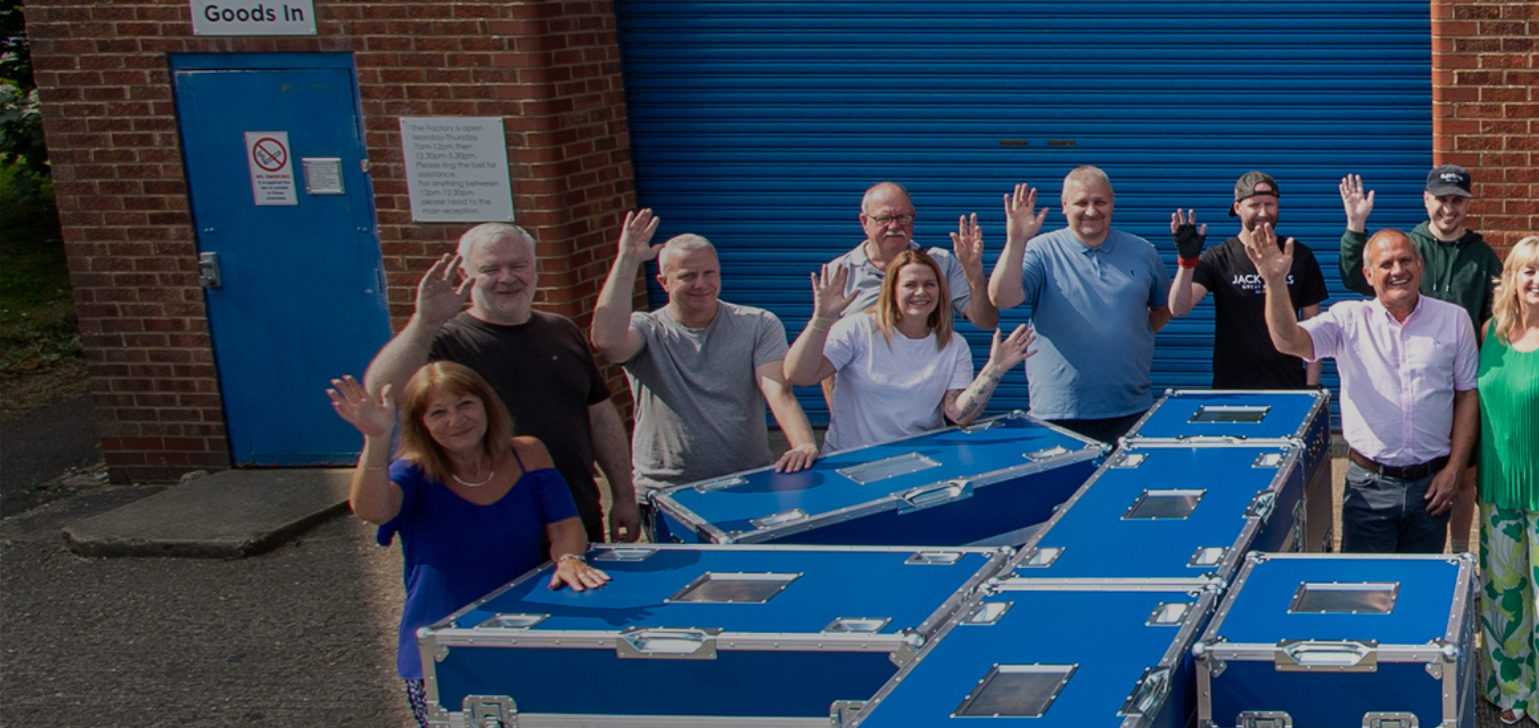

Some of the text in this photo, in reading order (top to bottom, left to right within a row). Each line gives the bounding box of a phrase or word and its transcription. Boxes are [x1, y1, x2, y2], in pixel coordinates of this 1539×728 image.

[204, 4, 305, 22] Goods In
[412, 124, 483, 133] The Factory is open
[442, 162, 456, 170] ring
[432, 180, 464, 188] anything
[1232, 274, 1262, 285] JACK
